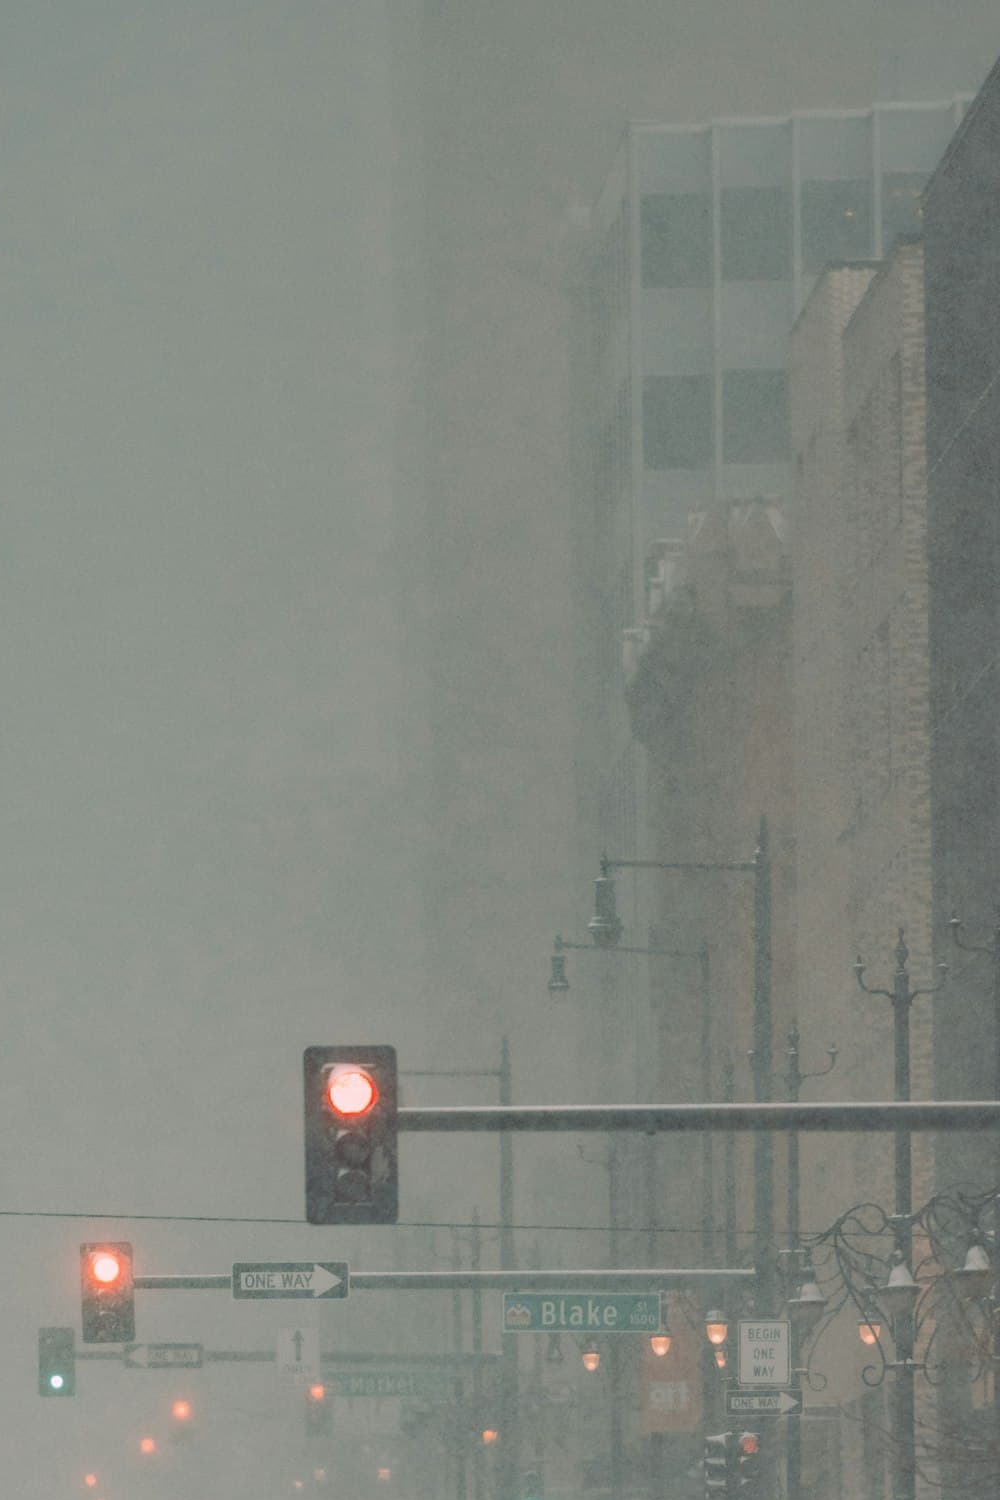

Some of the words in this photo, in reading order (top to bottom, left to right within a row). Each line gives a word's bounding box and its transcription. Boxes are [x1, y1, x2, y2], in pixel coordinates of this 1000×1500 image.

[244, 1273, 275, 1289] ONE
[281, 1273, 313, 1289] WAY
[540, 1300, 617, 1326] Blake
[747, 1328, 781, 1340] BEGIN
[753, 1347, 775, 1360] ONE
[753, 1366, 775, 1378] WAY
[351, 1375, 414, 1394] Market
[733, 1397, 754, 1409] ONE
[758, 1397, 780, 1409] WAY
